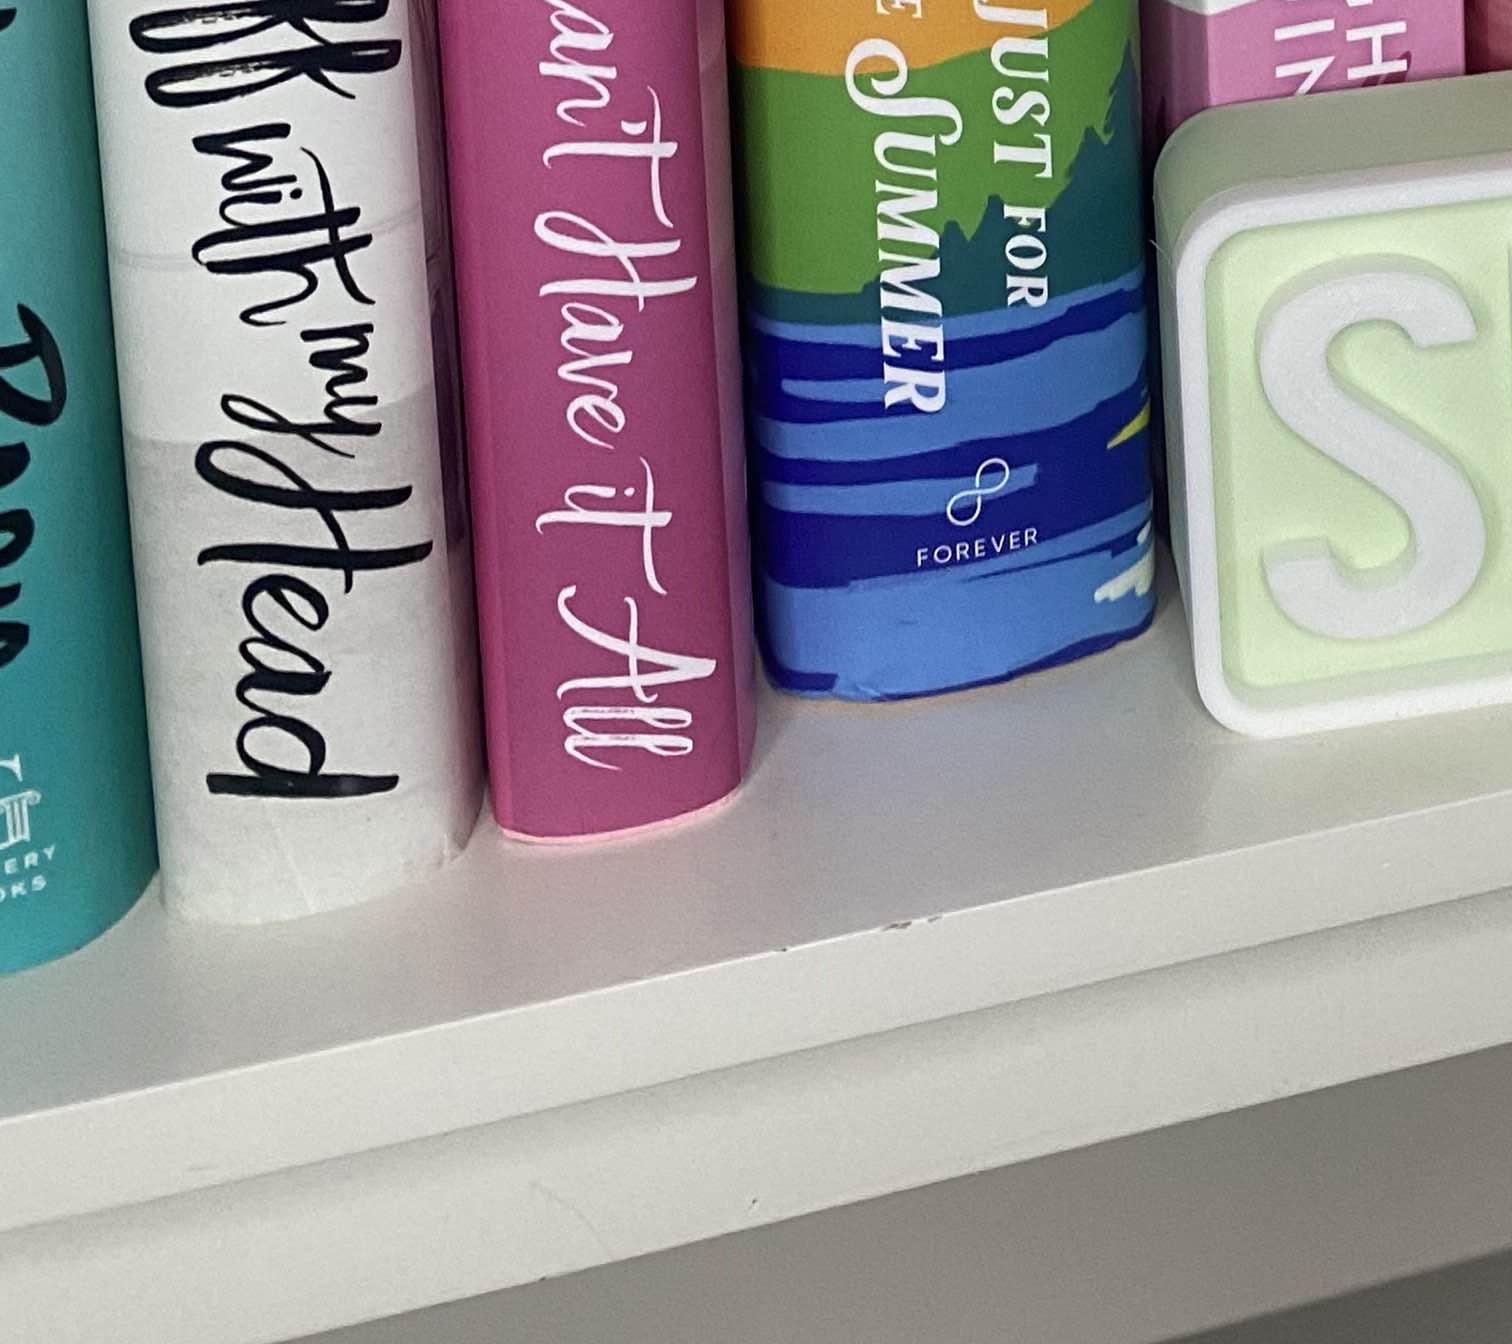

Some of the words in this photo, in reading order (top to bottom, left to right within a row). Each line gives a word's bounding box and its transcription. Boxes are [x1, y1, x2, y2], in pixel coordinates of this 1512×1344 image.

[192, 122, 376, 326] with
[845, 39, 963, 414] SUMMER
[1003, 204, 1049, 308] FOR
[221, 321, 383, 458] my
[534, 210, 698, 450] Have
[194, 438, 434, 798] Head
[535, 456, 674, 596] it
[916, 526, 1039, 567] FOREVER
[556, 584, 718, 772] All
